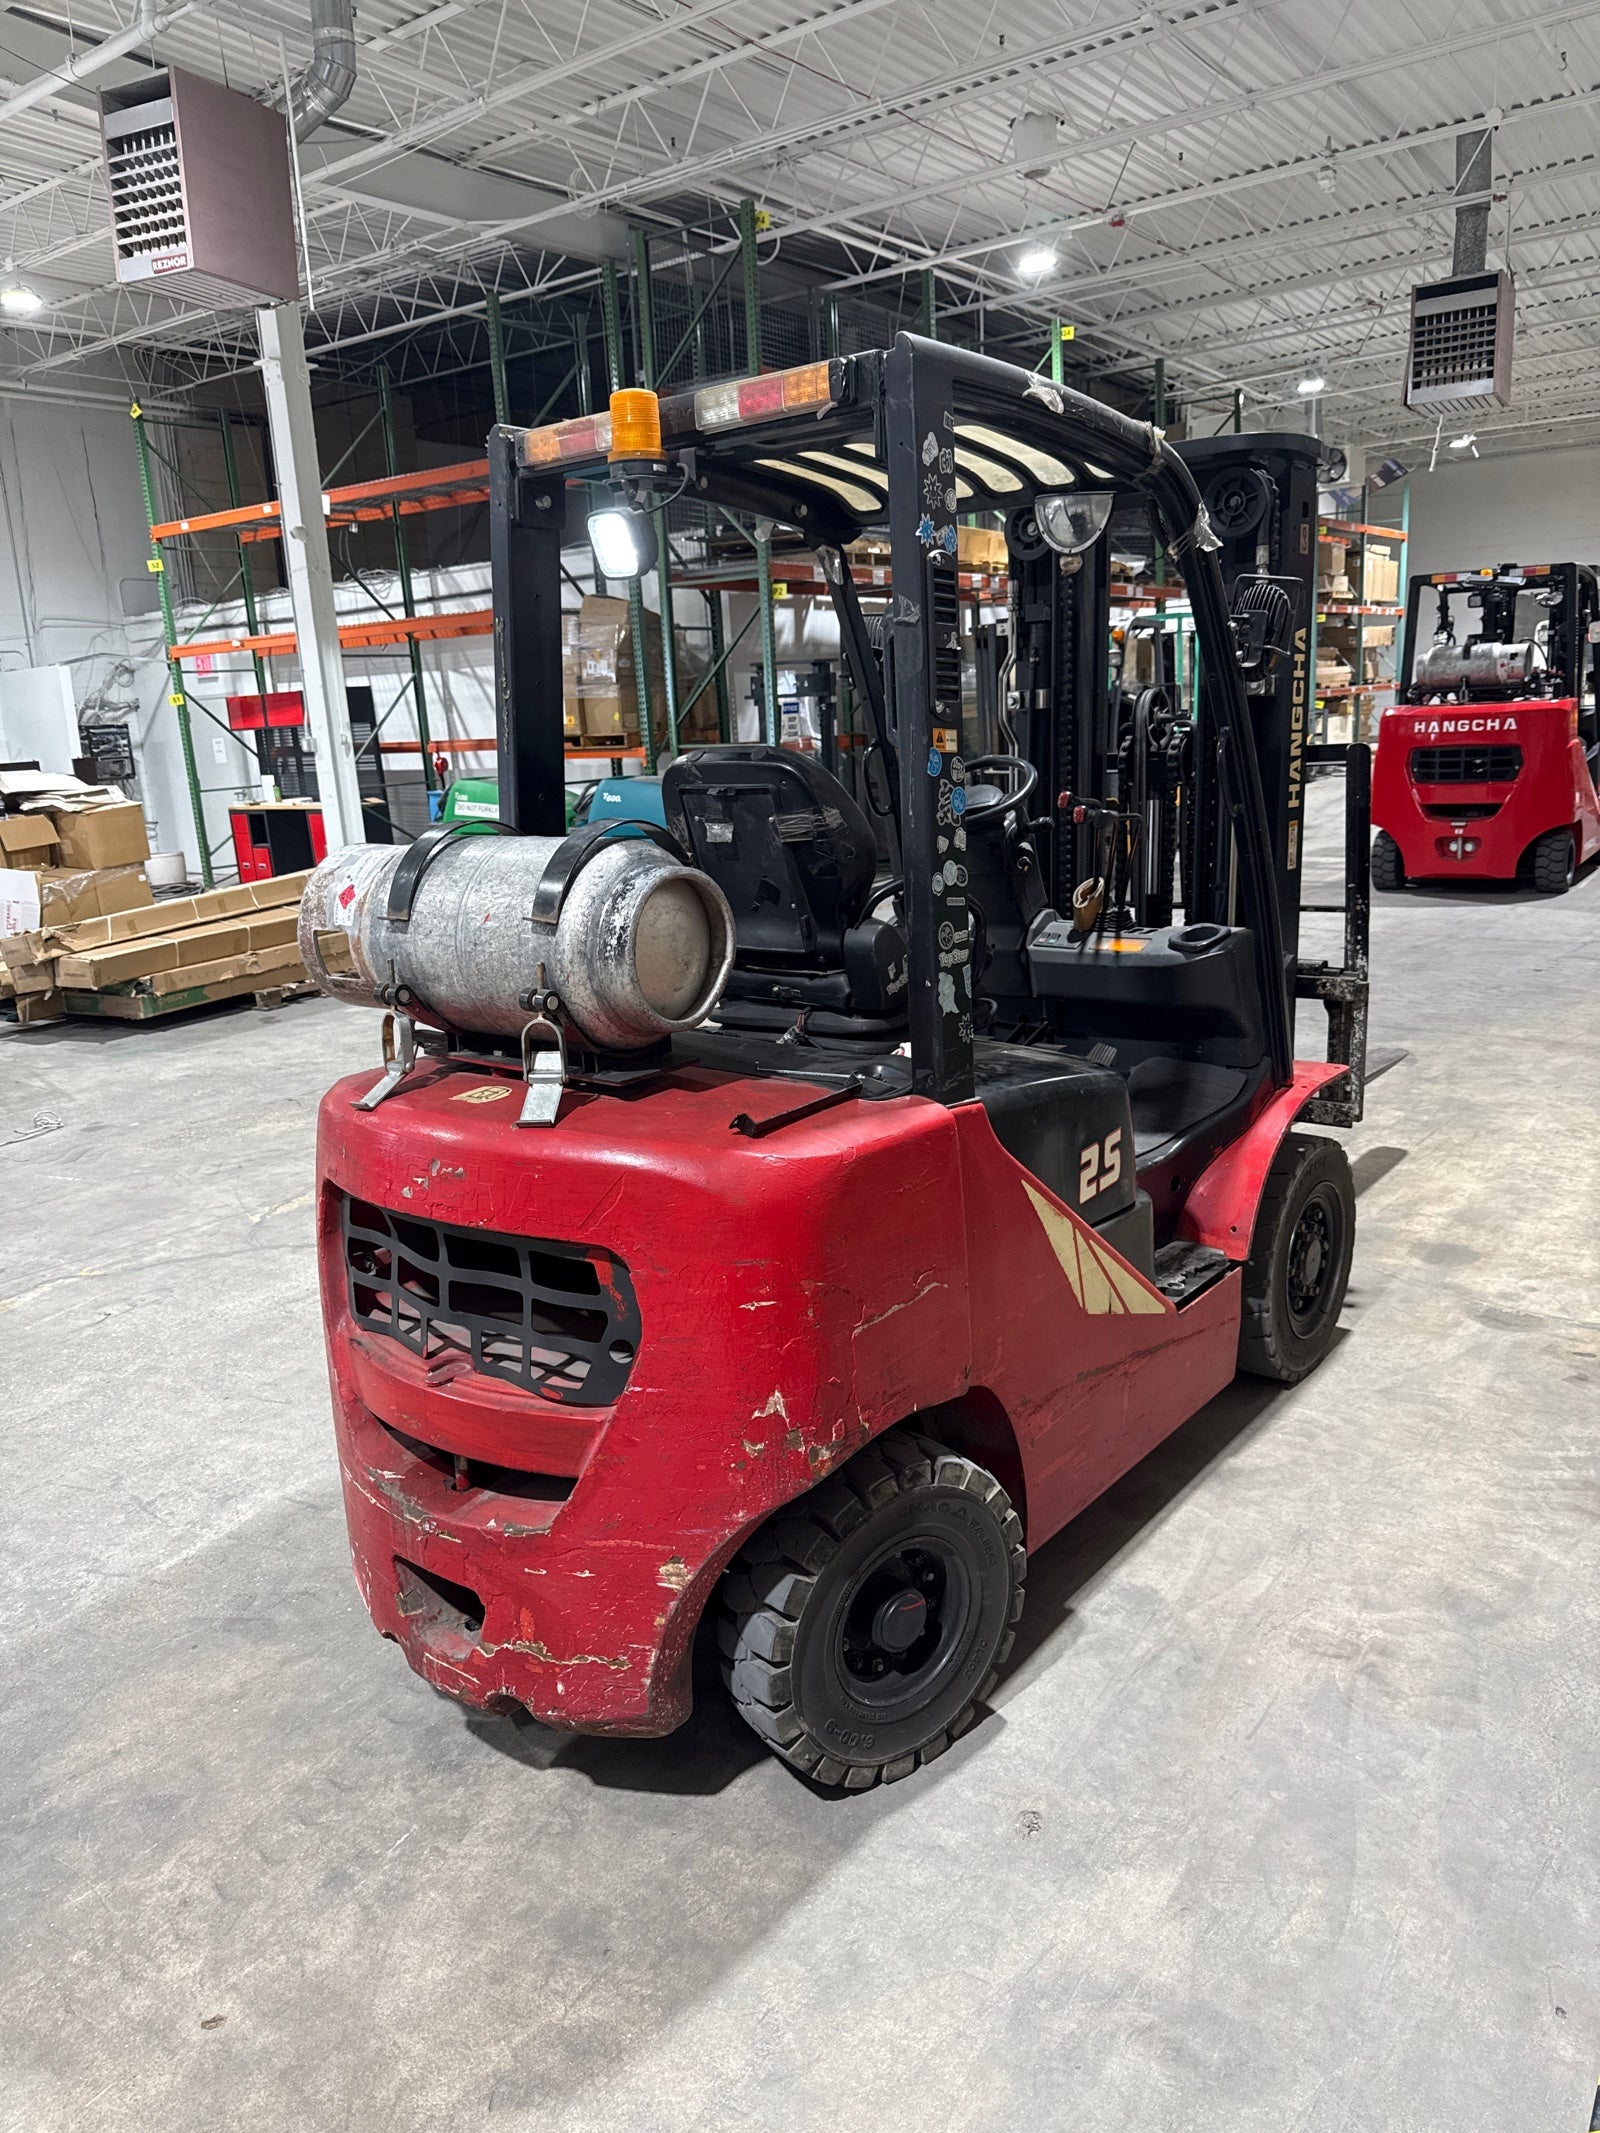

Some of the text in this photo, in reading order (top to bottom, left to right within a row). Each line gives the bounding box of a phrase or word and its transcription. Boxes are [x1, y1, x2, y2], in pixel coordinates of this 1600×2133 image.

[152, 255, 187, 271] REZNOR
[1287, 627, 1306, 808] HANGCHA
[1413, 717, 1518, 734] HANGCHA
[1078, 1125, 1123, 1205] 25
